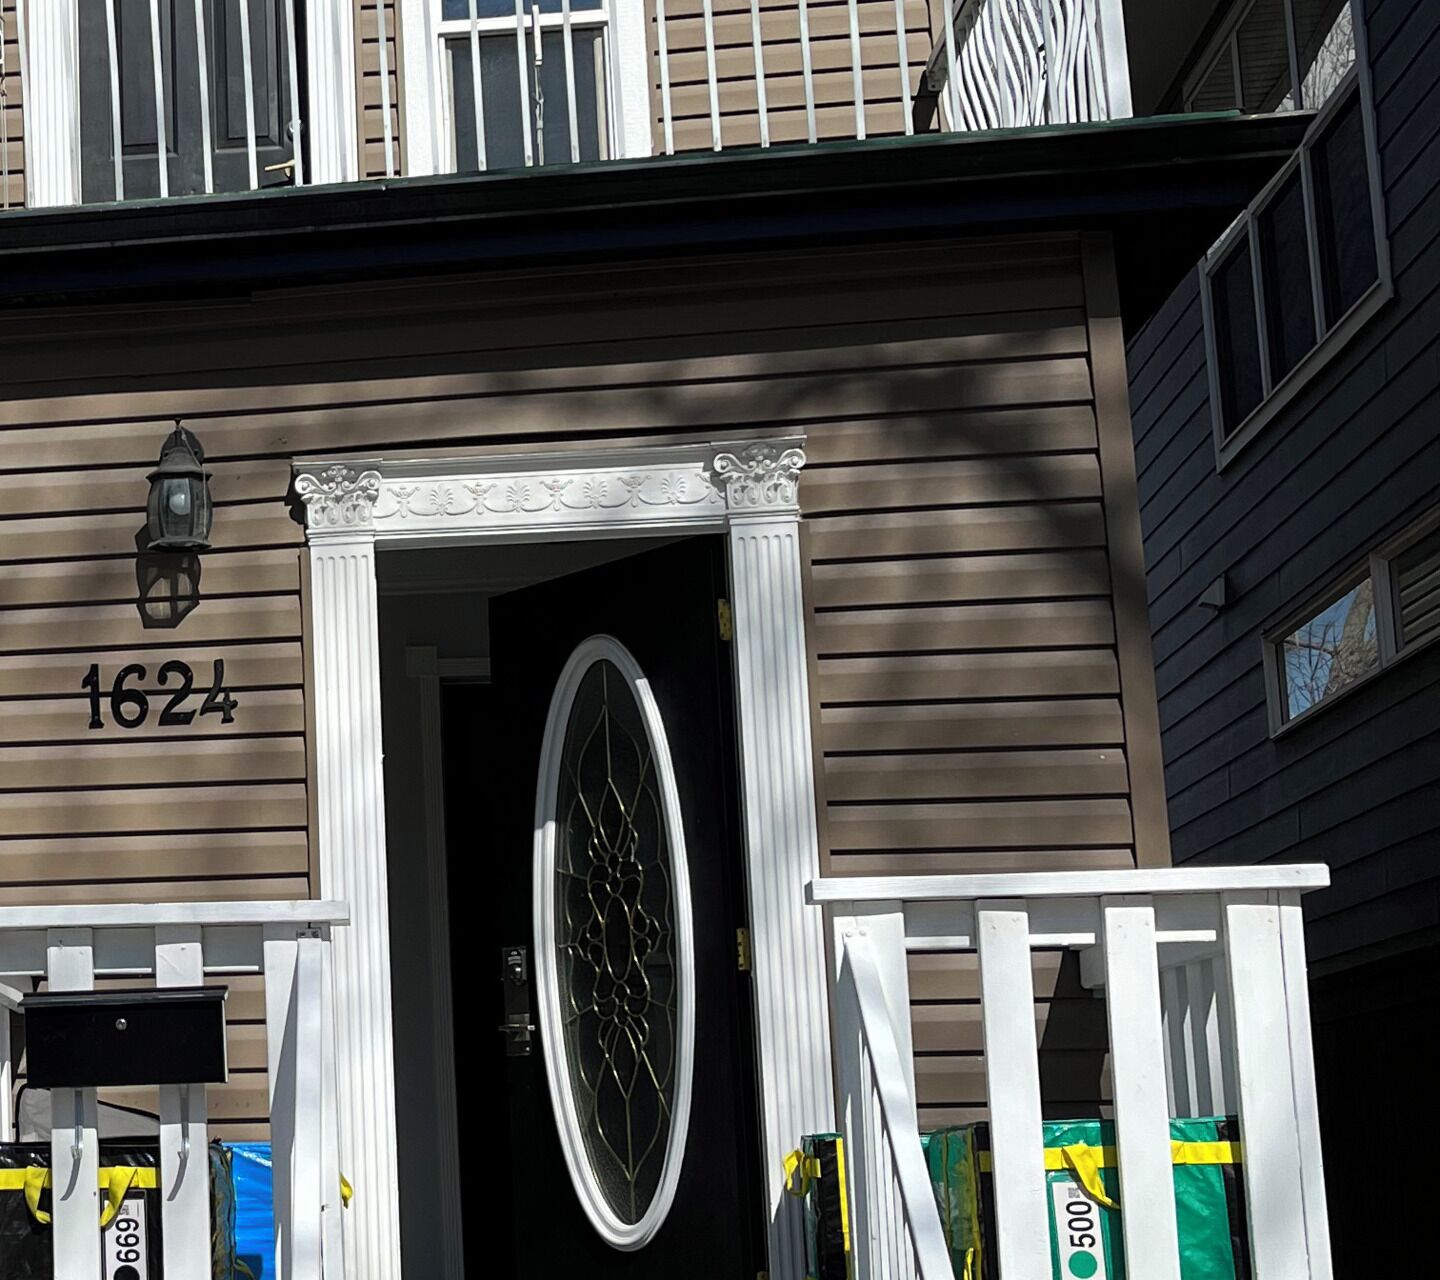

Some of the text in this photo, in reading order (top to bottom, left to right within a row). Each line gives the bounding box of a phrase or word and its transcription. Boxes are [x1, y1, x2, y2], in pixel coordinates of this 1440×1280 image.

[81, 658, 238, 729] 1624
[115, 1218, 140, 1263] 669
[1065, 1201, 1096, 1248] 500
